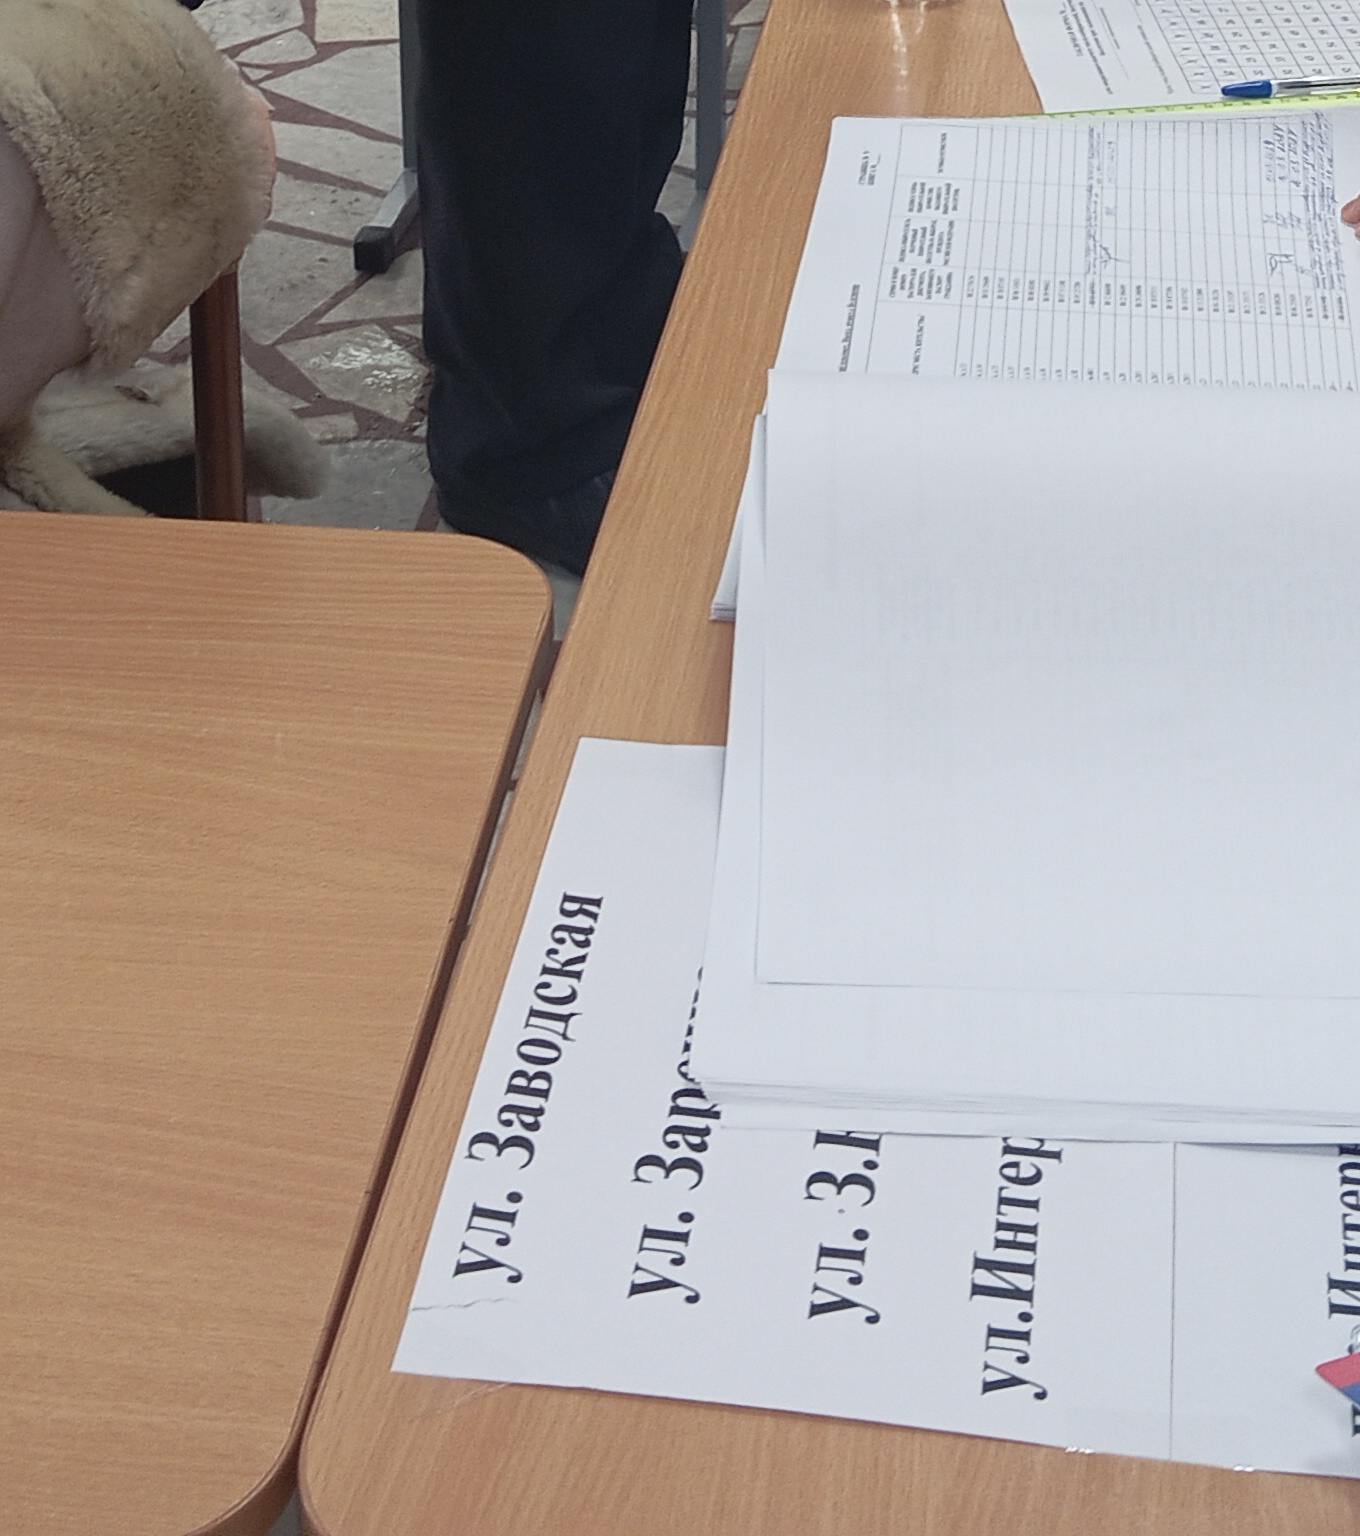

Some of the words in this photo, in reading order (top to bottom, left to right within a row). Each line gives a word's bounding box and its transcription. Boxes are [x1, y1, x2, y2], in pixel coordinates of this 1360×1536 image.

[464, 891, 604, 1170] Заводская
[452, 1191, 524, 1284] ул.
[627, 1211, 701, 1305] ул.
[807, 1228, 881, 1325] ул.
